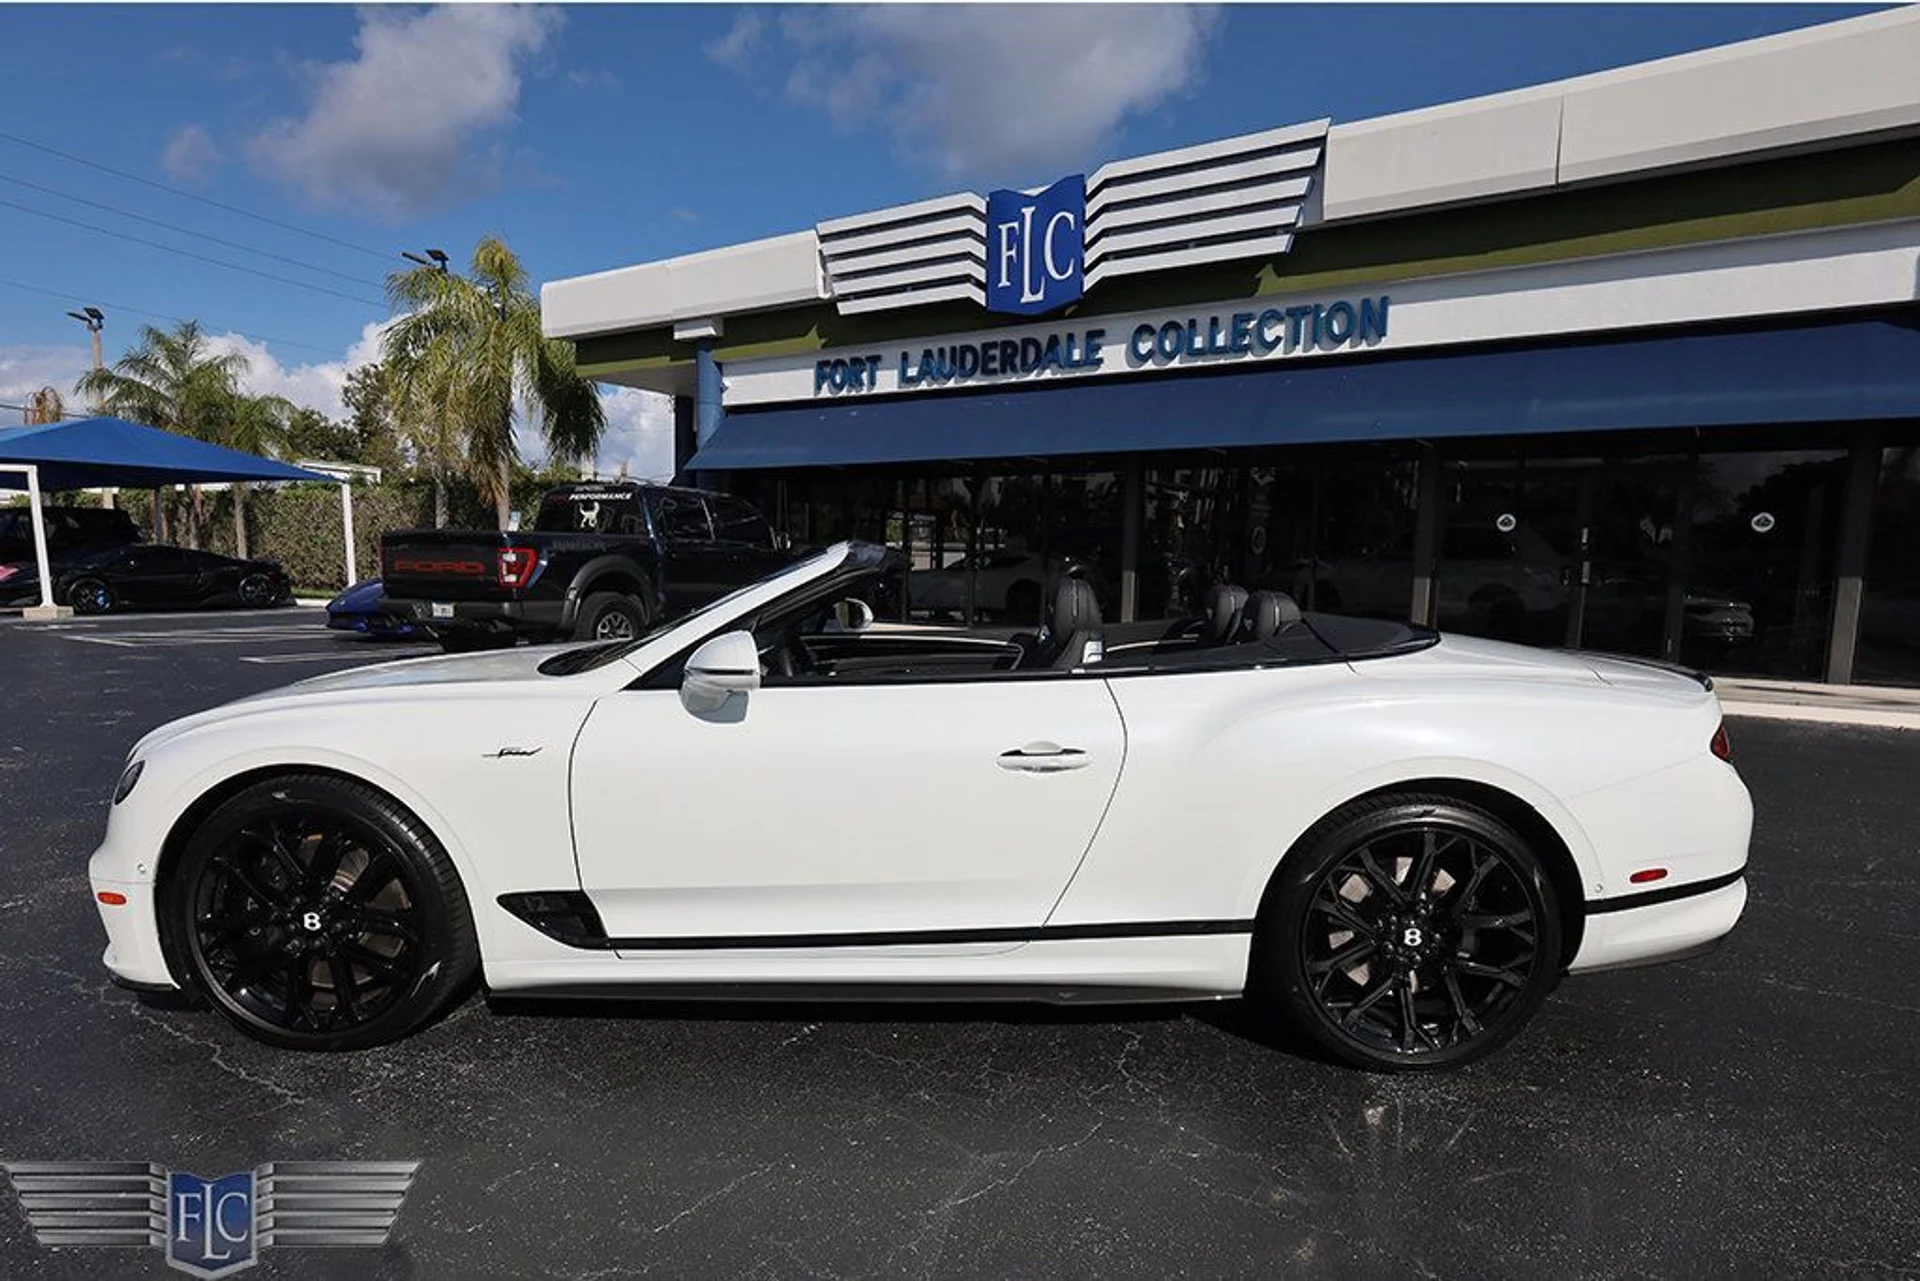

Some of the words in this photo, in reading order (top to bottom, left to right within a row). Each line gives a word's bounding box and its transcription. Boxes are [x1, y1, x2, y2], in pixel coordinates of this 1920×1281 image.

[997, 206, 1075, 304] FLC
[814, 354, 881, 393] FORT
[900, 329, 1105, 384] LAUDERDALE
[1130, 296, 1390, 361] COLLECTION
